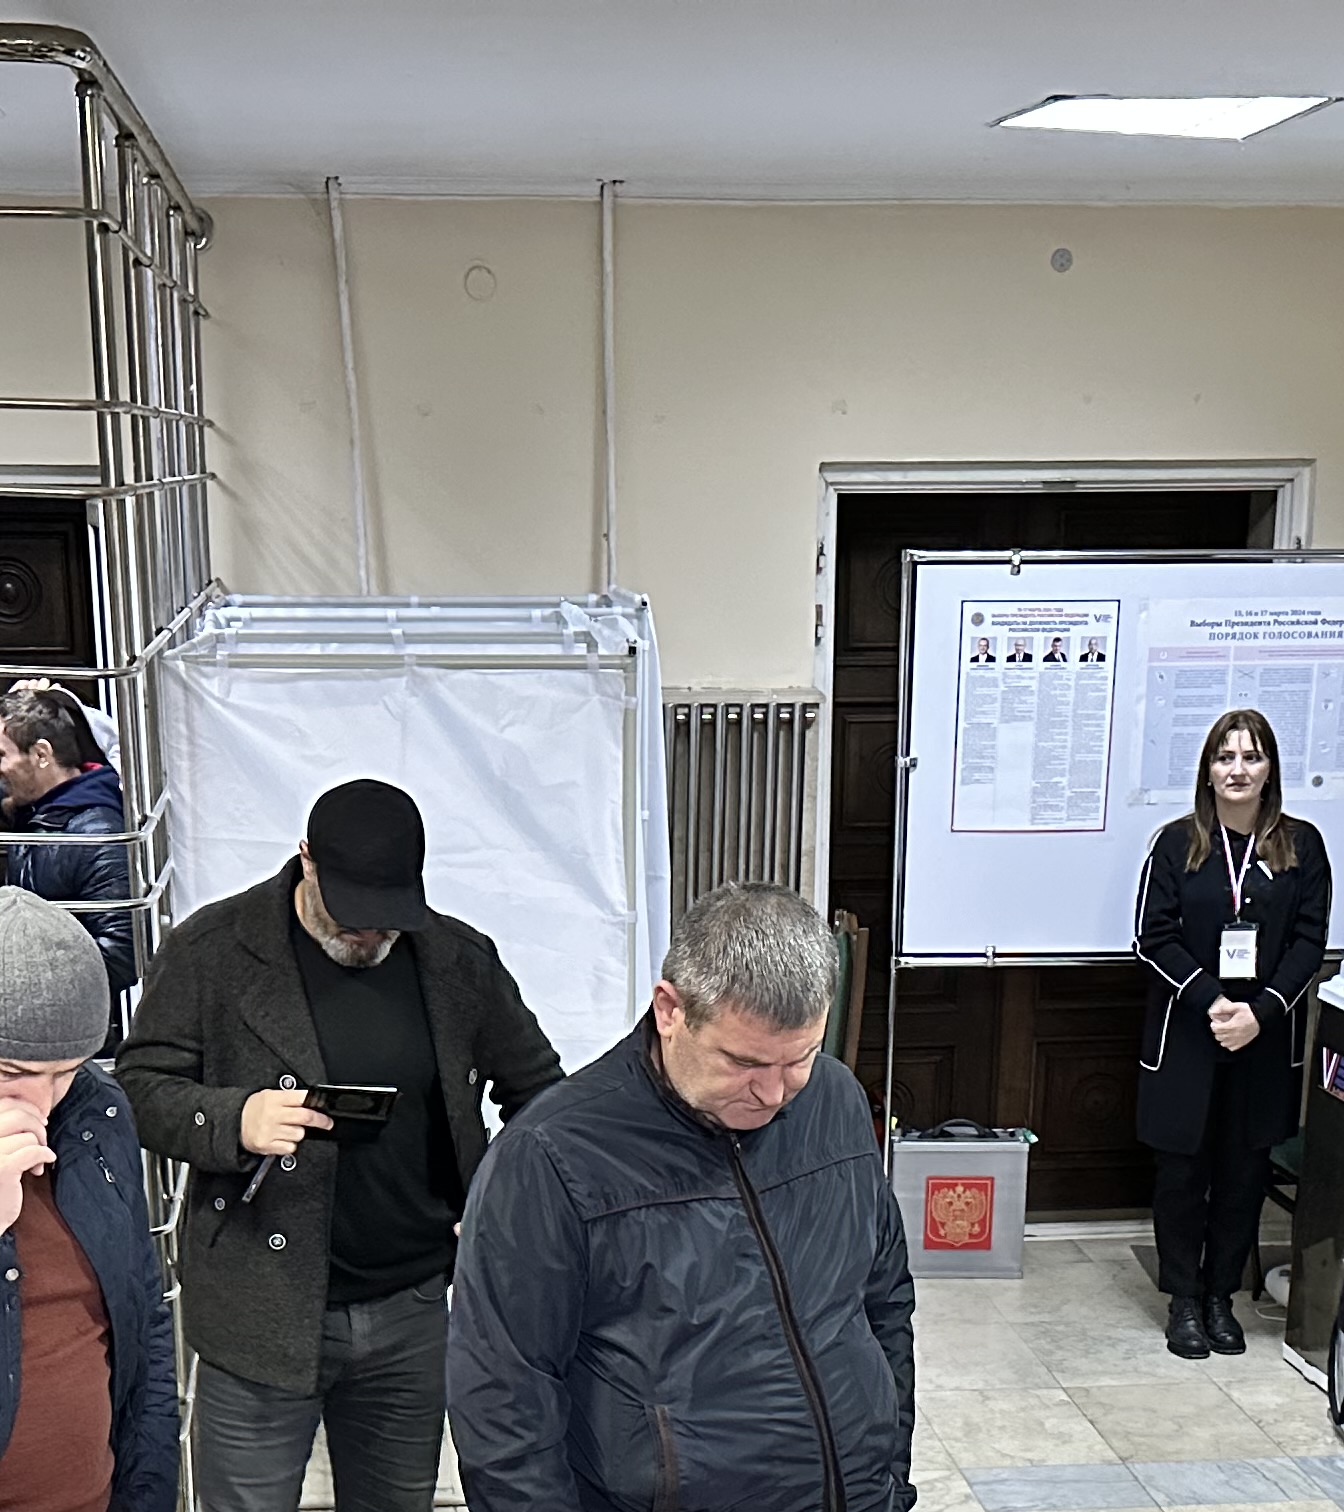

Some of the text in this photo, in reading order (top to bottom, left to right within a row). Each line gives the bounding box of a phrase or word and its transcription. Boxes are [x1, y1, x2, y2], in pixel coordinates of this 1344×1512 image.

[1225, 619, 1271, 628] Президента
[1273, 618, 1318, 627] Российской
[1208, 630, 1344, 641] ПОРЯДОК ГОЛОСОВАНИЯ
